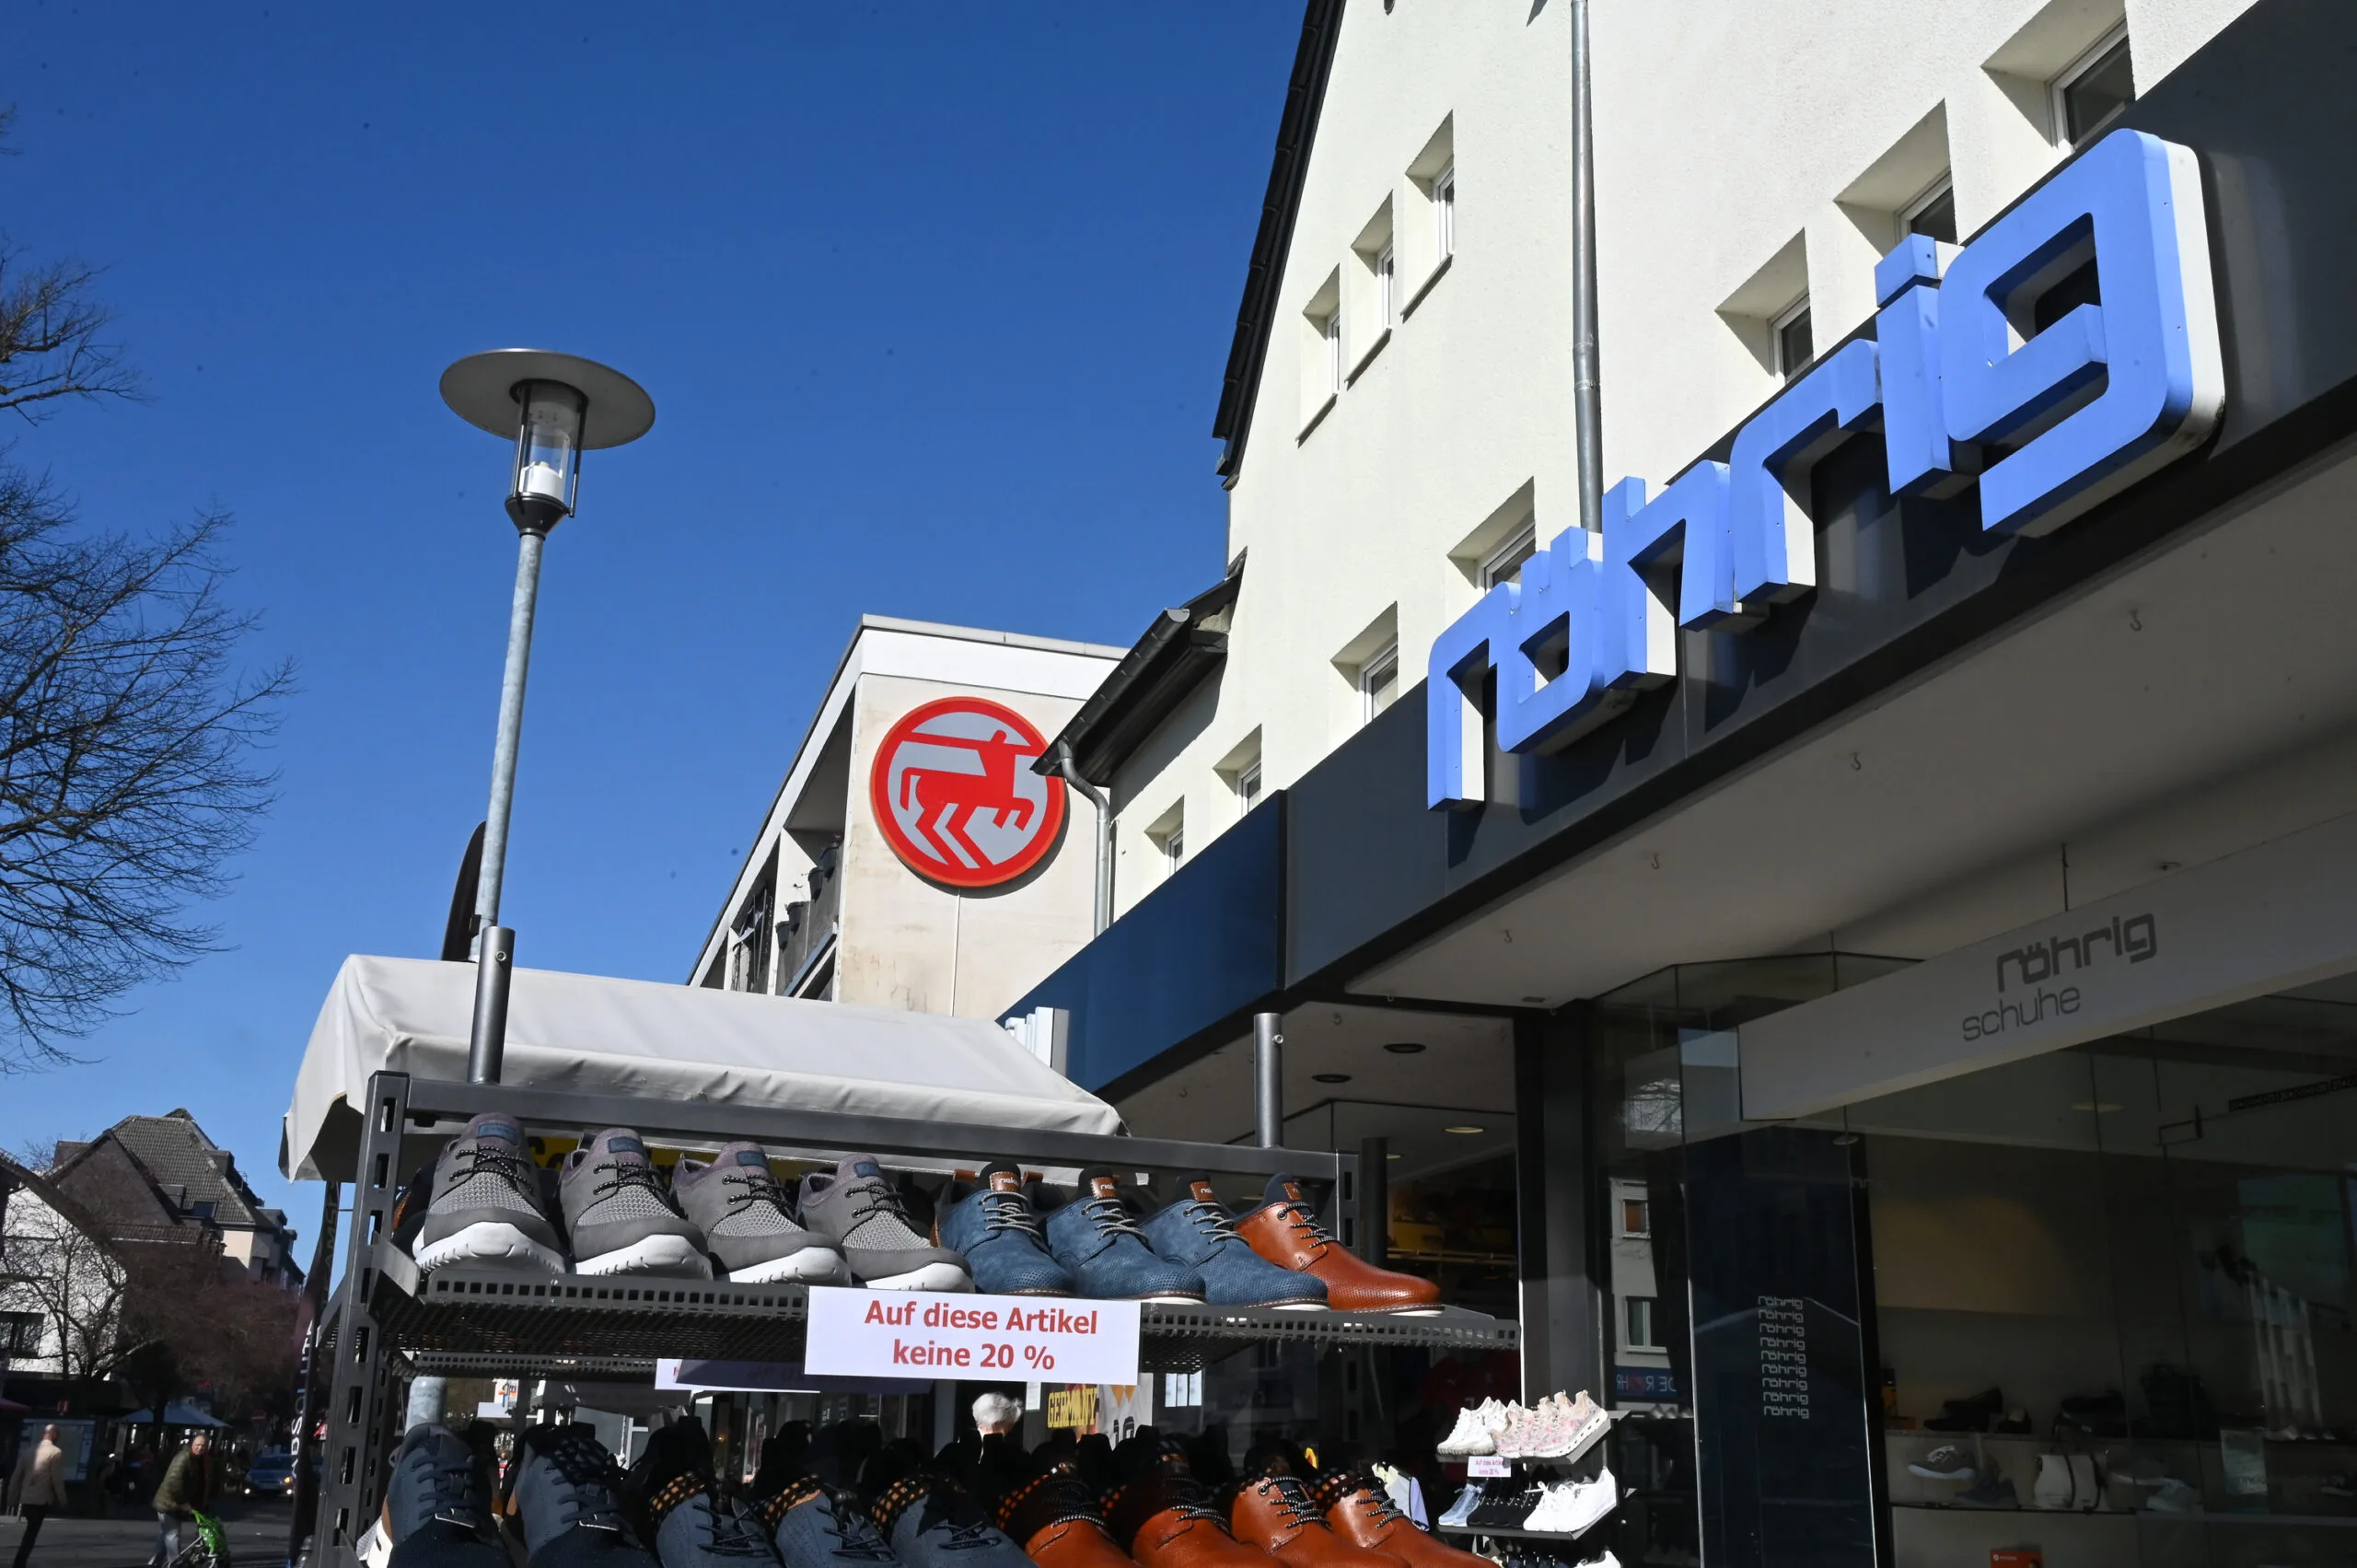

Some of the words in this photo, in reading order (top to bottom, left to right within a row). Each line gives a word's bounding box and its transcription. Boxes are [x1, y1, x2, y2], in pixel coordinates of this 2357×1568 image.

[1427, 128, 2225, 811] röhrig
[1996, 912, 2157, 993] röhrig
[1962, 986, 2081, 1041] schuhe
[1758, 1295, 1803, 1309] röhrig
[865, 1300, 917, 1326] Auf
[923, 1302, 998, 1330] diese
[1005, 1307, 1097, 1334] Artikel
[1759, 1309, 1804, 1323] röhrig
[1759, 1323, 1805, 1337] röhrig
[1759, 1337, 1805, 1351] röhrig
[892, 1339, 970, 1366] keine
[980, 1343, 1015, 1368] 20
[1024, 1345, 1055, 1370] %
[1760, 1350, 1805, 1364] röhrig
[1761, 1364, 1806, 1376] röhrig
[1762, 1377, 1807, 1391] röhrig
[1763, 1391, 1808, 1405] röhrig
[1764, 1406, 1809, 1419] röhrig
